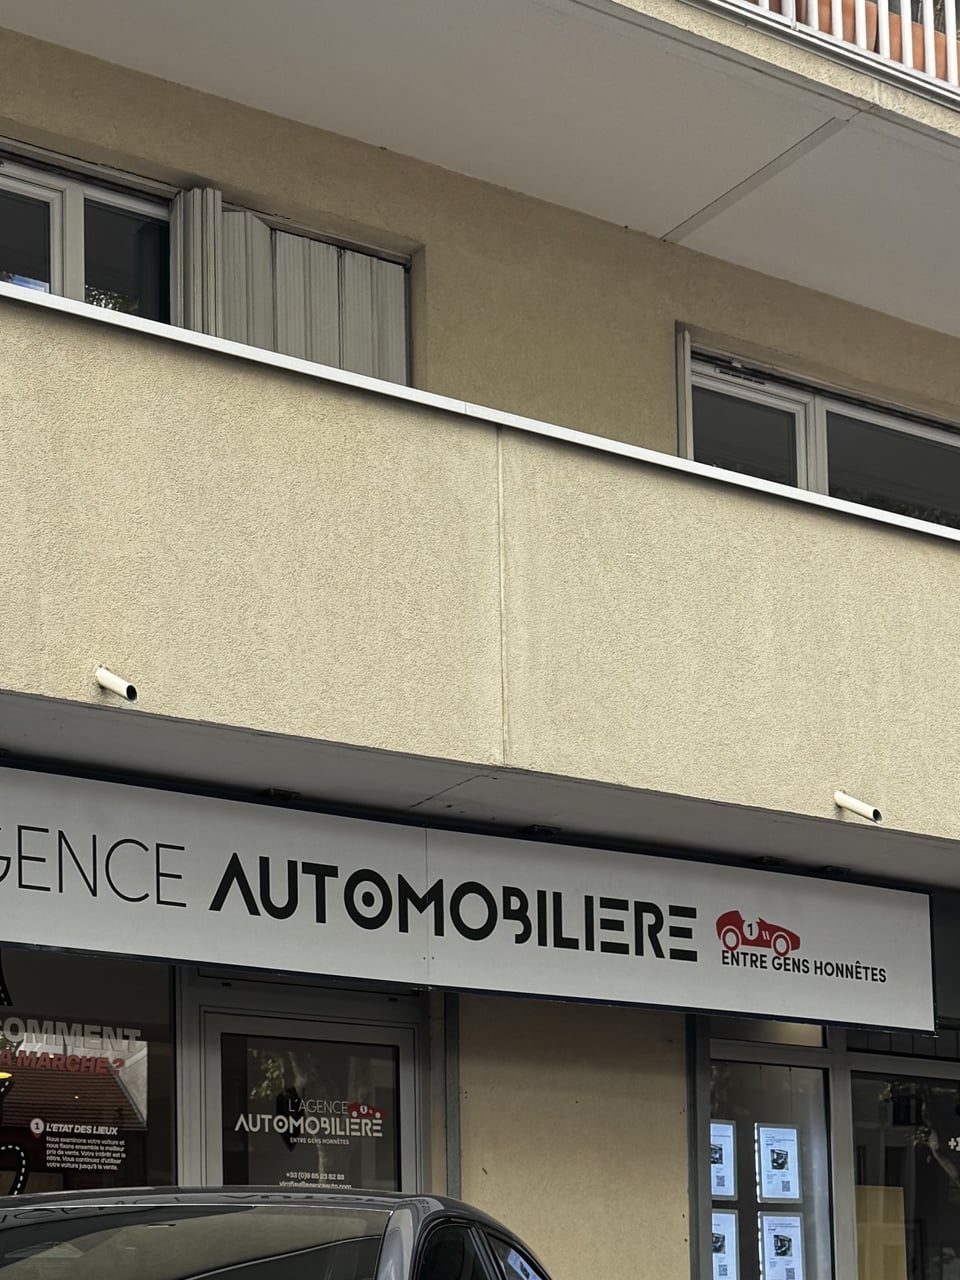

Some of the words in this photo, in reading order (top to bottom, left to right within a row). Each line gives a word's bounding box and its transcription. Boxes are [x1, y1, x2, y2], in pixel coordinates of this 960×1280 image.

[209, 852, 698, 962] AUTOMOBILIERE
[721, 950, 767, 969] ENTRE
[771, 956, 810, 974] GENS
[814, 960, 887, 983] HONNÊTES
[16, 1050, 109, 1074] MARCHE
[288, 1099, 348, 1114] L'AGENCE
[46, 1123, 74, 1133] L'ETAT
[74, 1125, 92, 1134] DES
[93, 1126, 118, 1135] LIEUX
